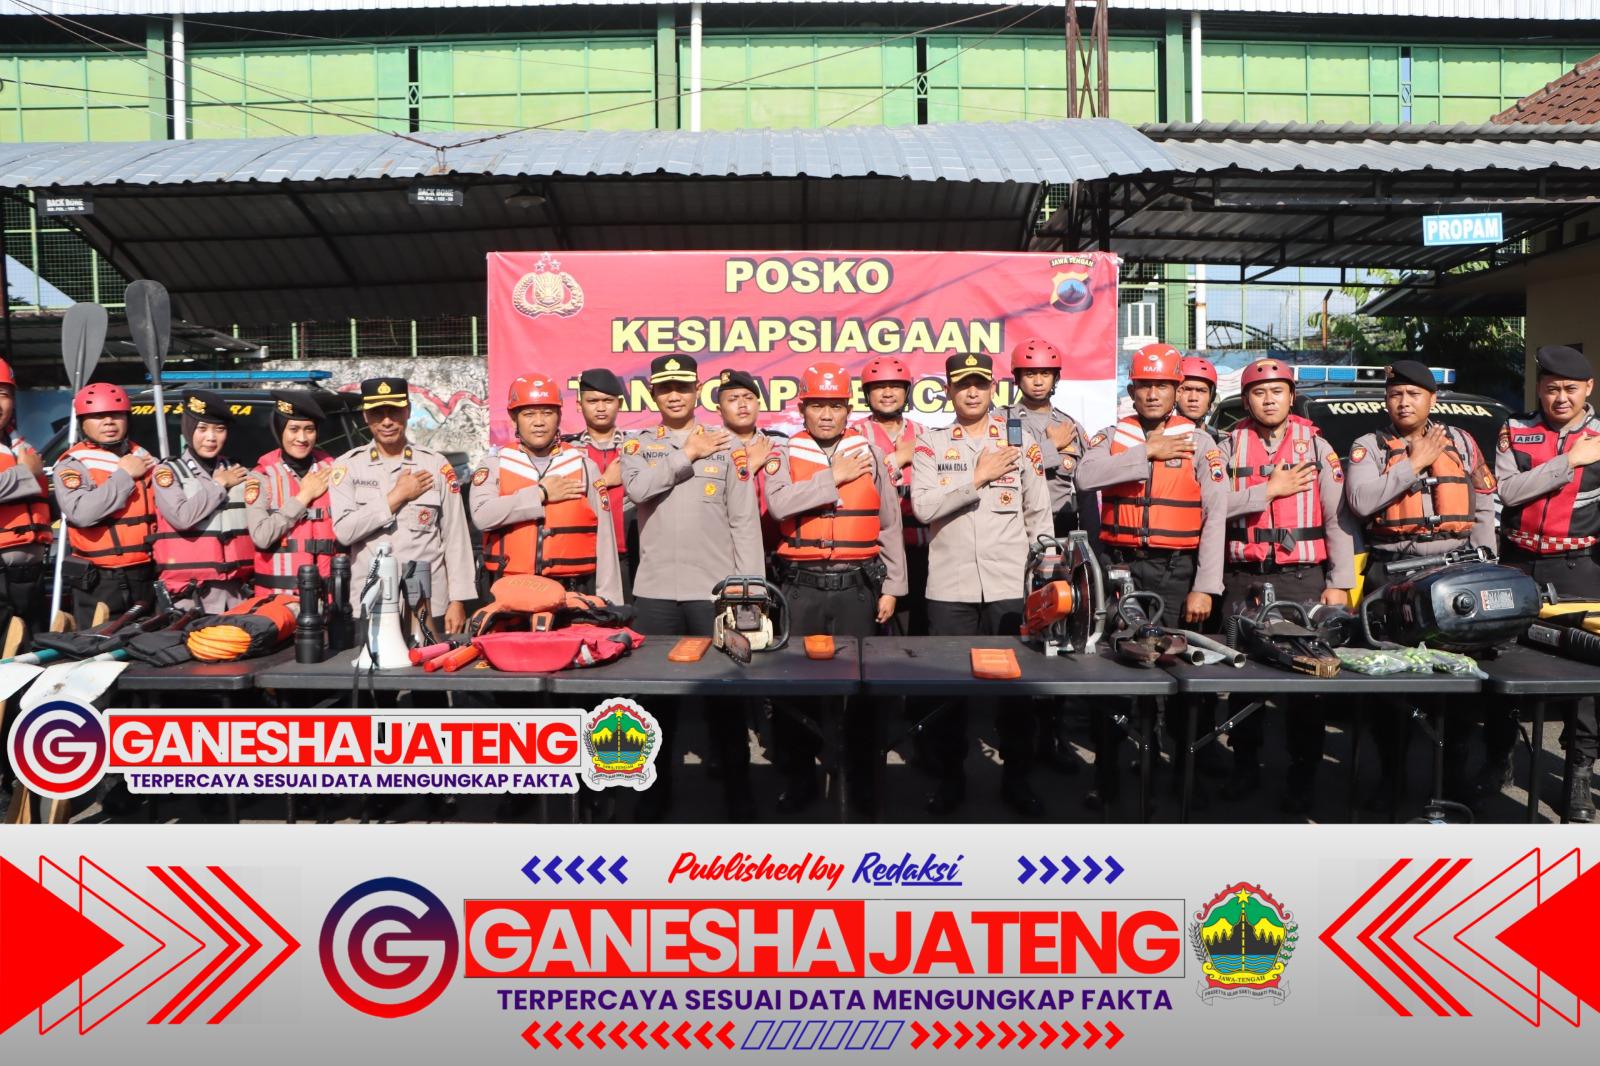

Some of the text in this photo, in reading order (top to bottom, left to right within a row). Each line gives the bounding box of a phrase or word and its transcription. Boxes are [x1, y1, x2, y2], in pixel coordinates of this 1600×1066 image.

[1427, 218, 1499, 241] PROPAM
[725, 258, 892, 294] POSKO
[611, 318, 1003, 354] KESIAPSIAGAAN
[1429, 402, 1493, 418] BHARA
